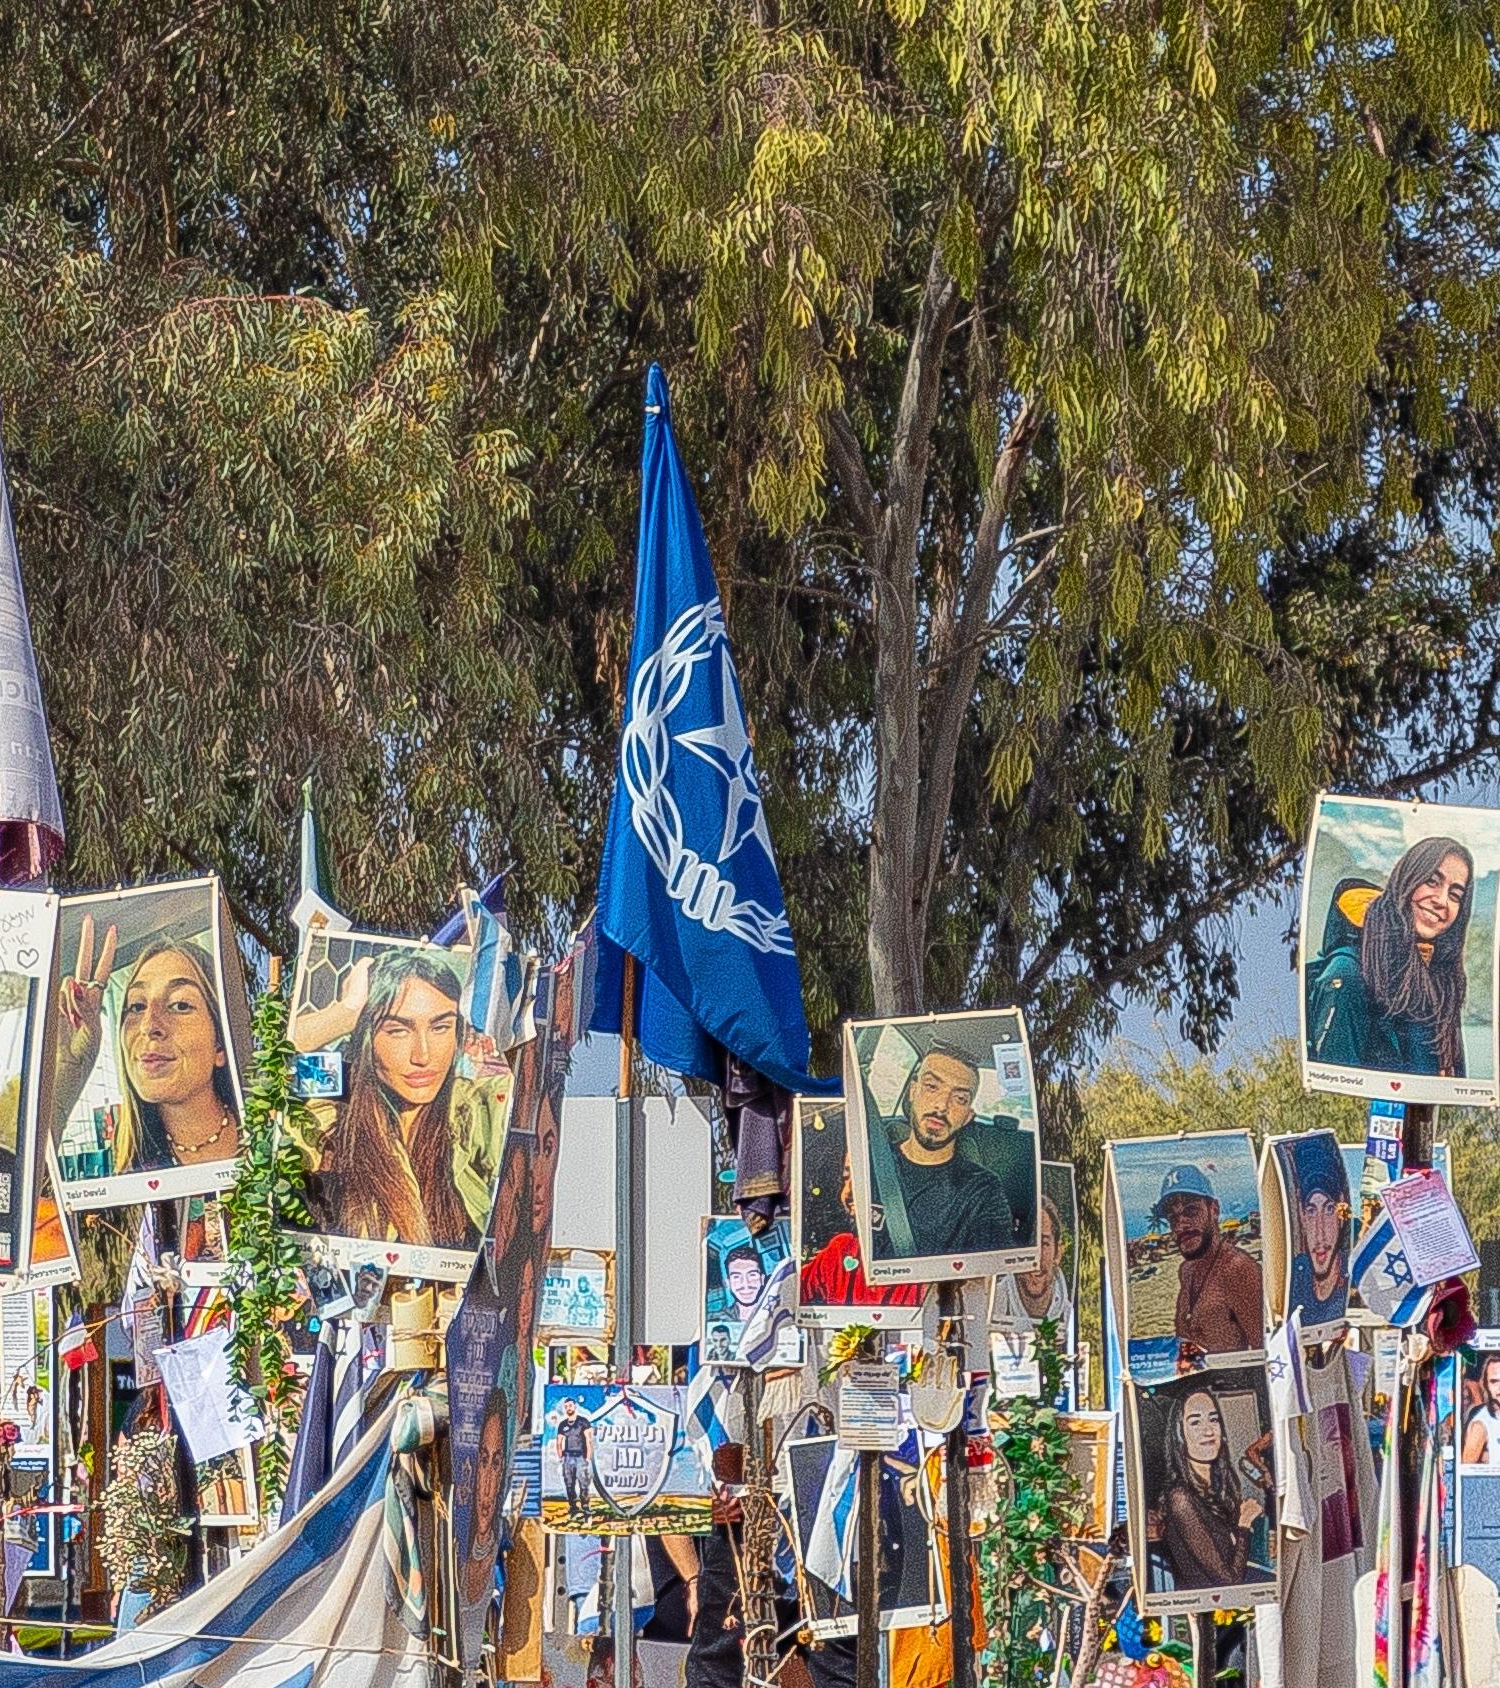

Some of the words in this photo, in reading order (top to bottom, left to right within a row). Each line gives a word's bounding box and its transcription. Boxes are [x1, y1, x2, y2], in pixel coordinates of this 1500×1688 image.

[1341, 1076, 1363, 1086] David
[83, 1188, 106, 1197] David
[116, 1374, 134, 1389] Th
[613, 1448, 644, 1471] מגן
